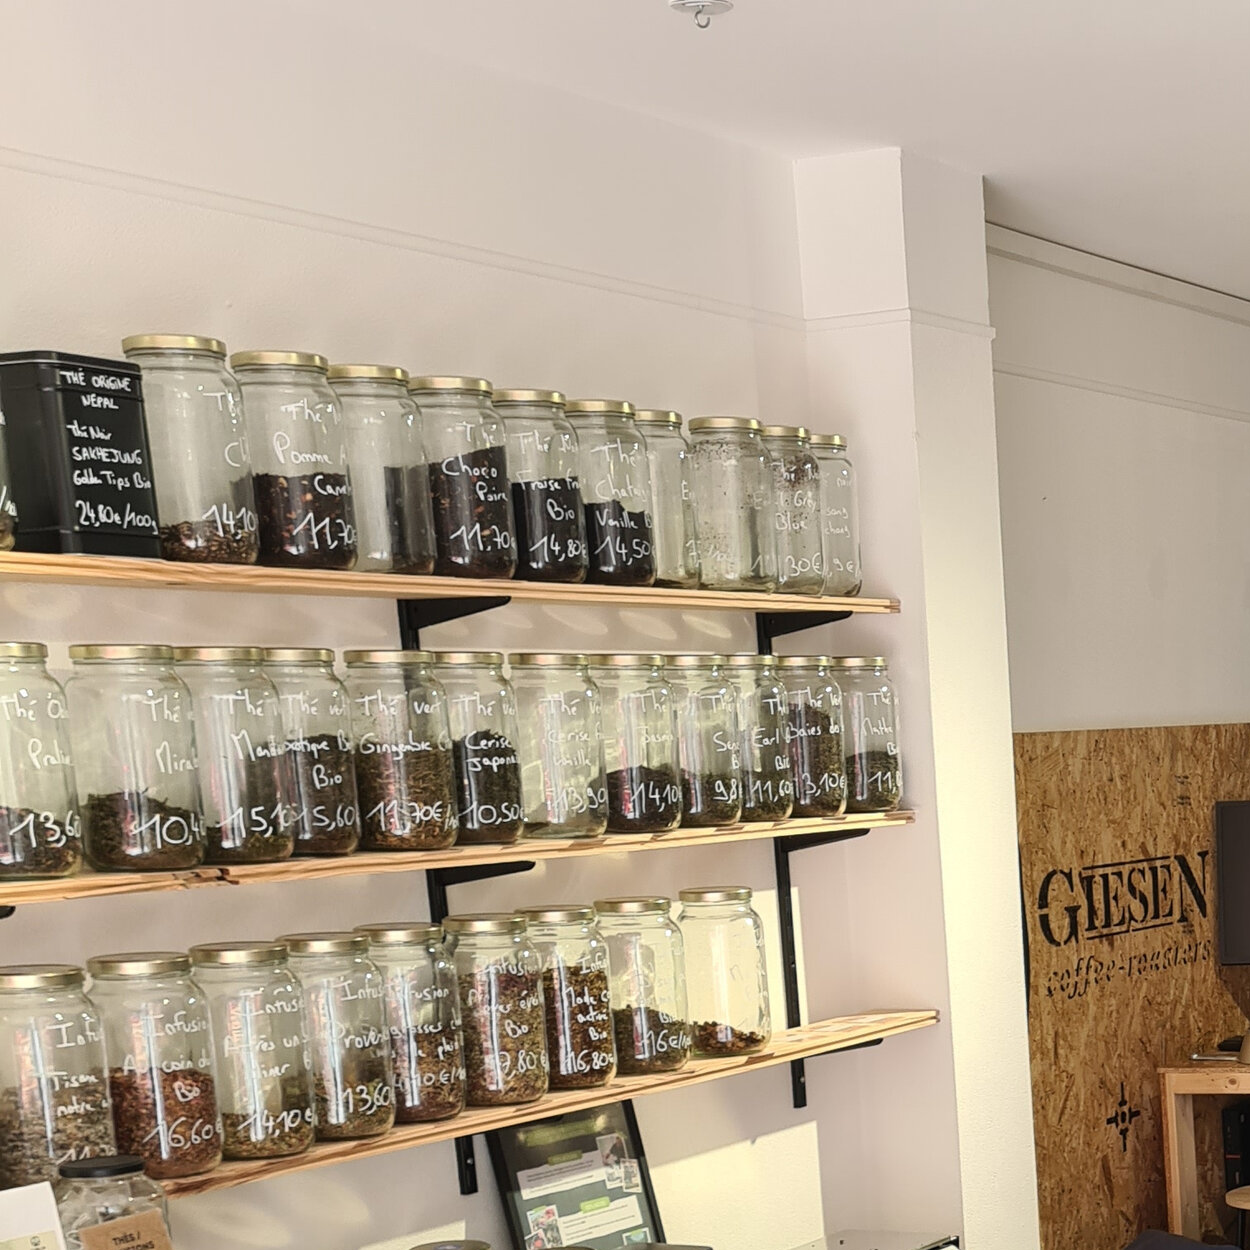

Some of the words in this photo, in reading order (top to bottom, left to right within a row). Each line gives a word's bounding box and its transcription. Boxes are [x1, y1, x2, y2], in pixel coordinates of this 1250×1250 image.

[60, 368, 86, 386] THÉ
[273, 431, 333, 465] Pomme
[590, 437, 637, 467] Thé
[441, 453, 498, 479] Choco
[134, 472, 151, 488] Bio
[546, 498, 576, 521] Bio
[595, 508, 638, 529] Vanille
[355, 688, 400, 717] Thé
[451, 691, 495, 717] Thé
[312, 764, 343, 790] Bio
[1038, 850, 1210, 948] GIESEN
[504, 1018, 529, 1039] Bio
